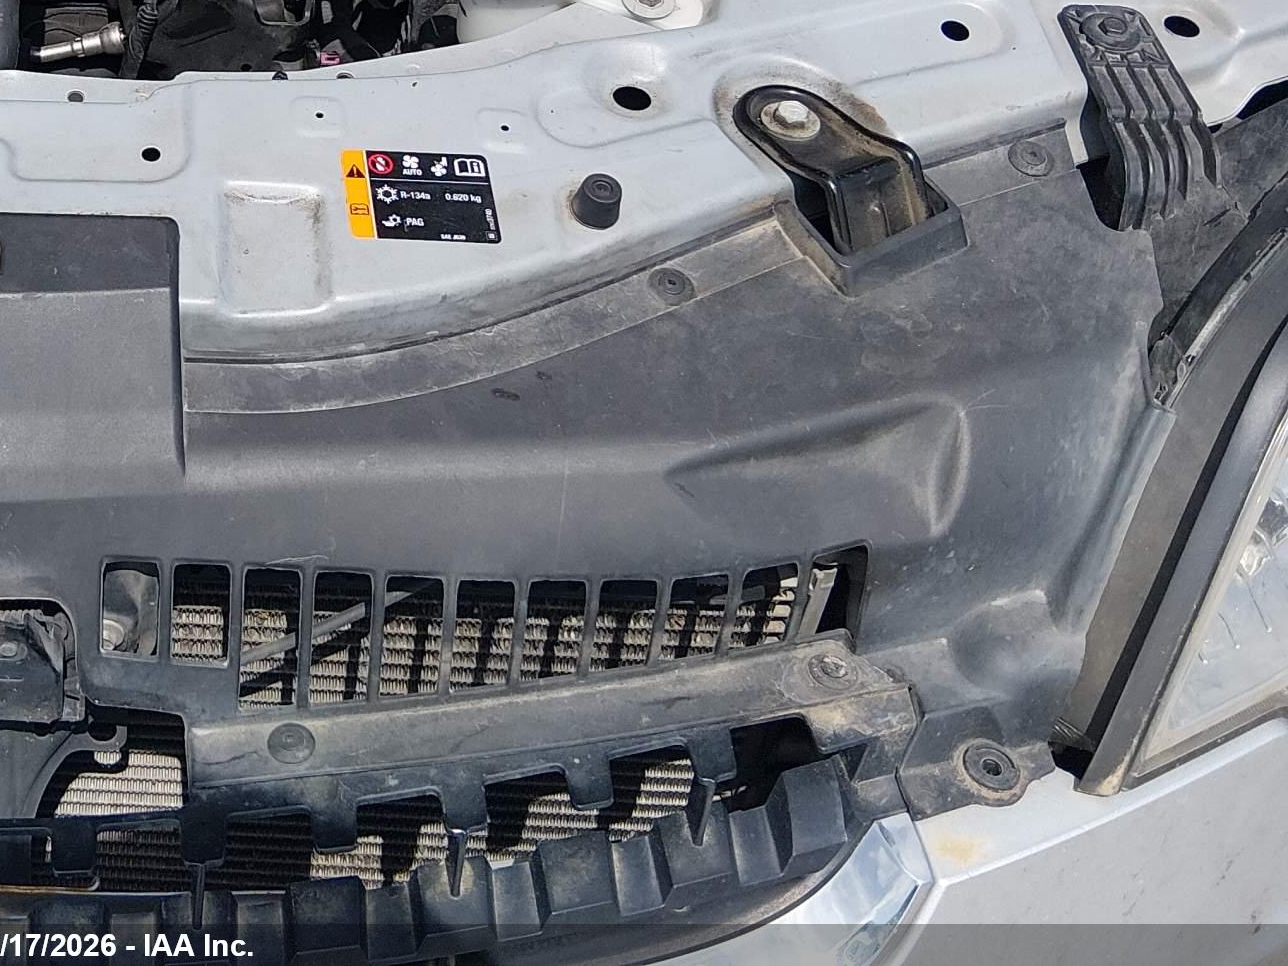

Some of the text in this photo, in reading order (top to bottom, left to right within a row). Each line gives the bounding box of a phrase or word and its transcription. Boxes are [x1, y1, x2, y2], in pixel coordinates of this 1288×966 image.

[402, 168, 423, 176] AUTO
[400, 191, 432, 200] R-134a
[470, 194, 482, 203] kg
[406, 218, 425, 227] PAG
